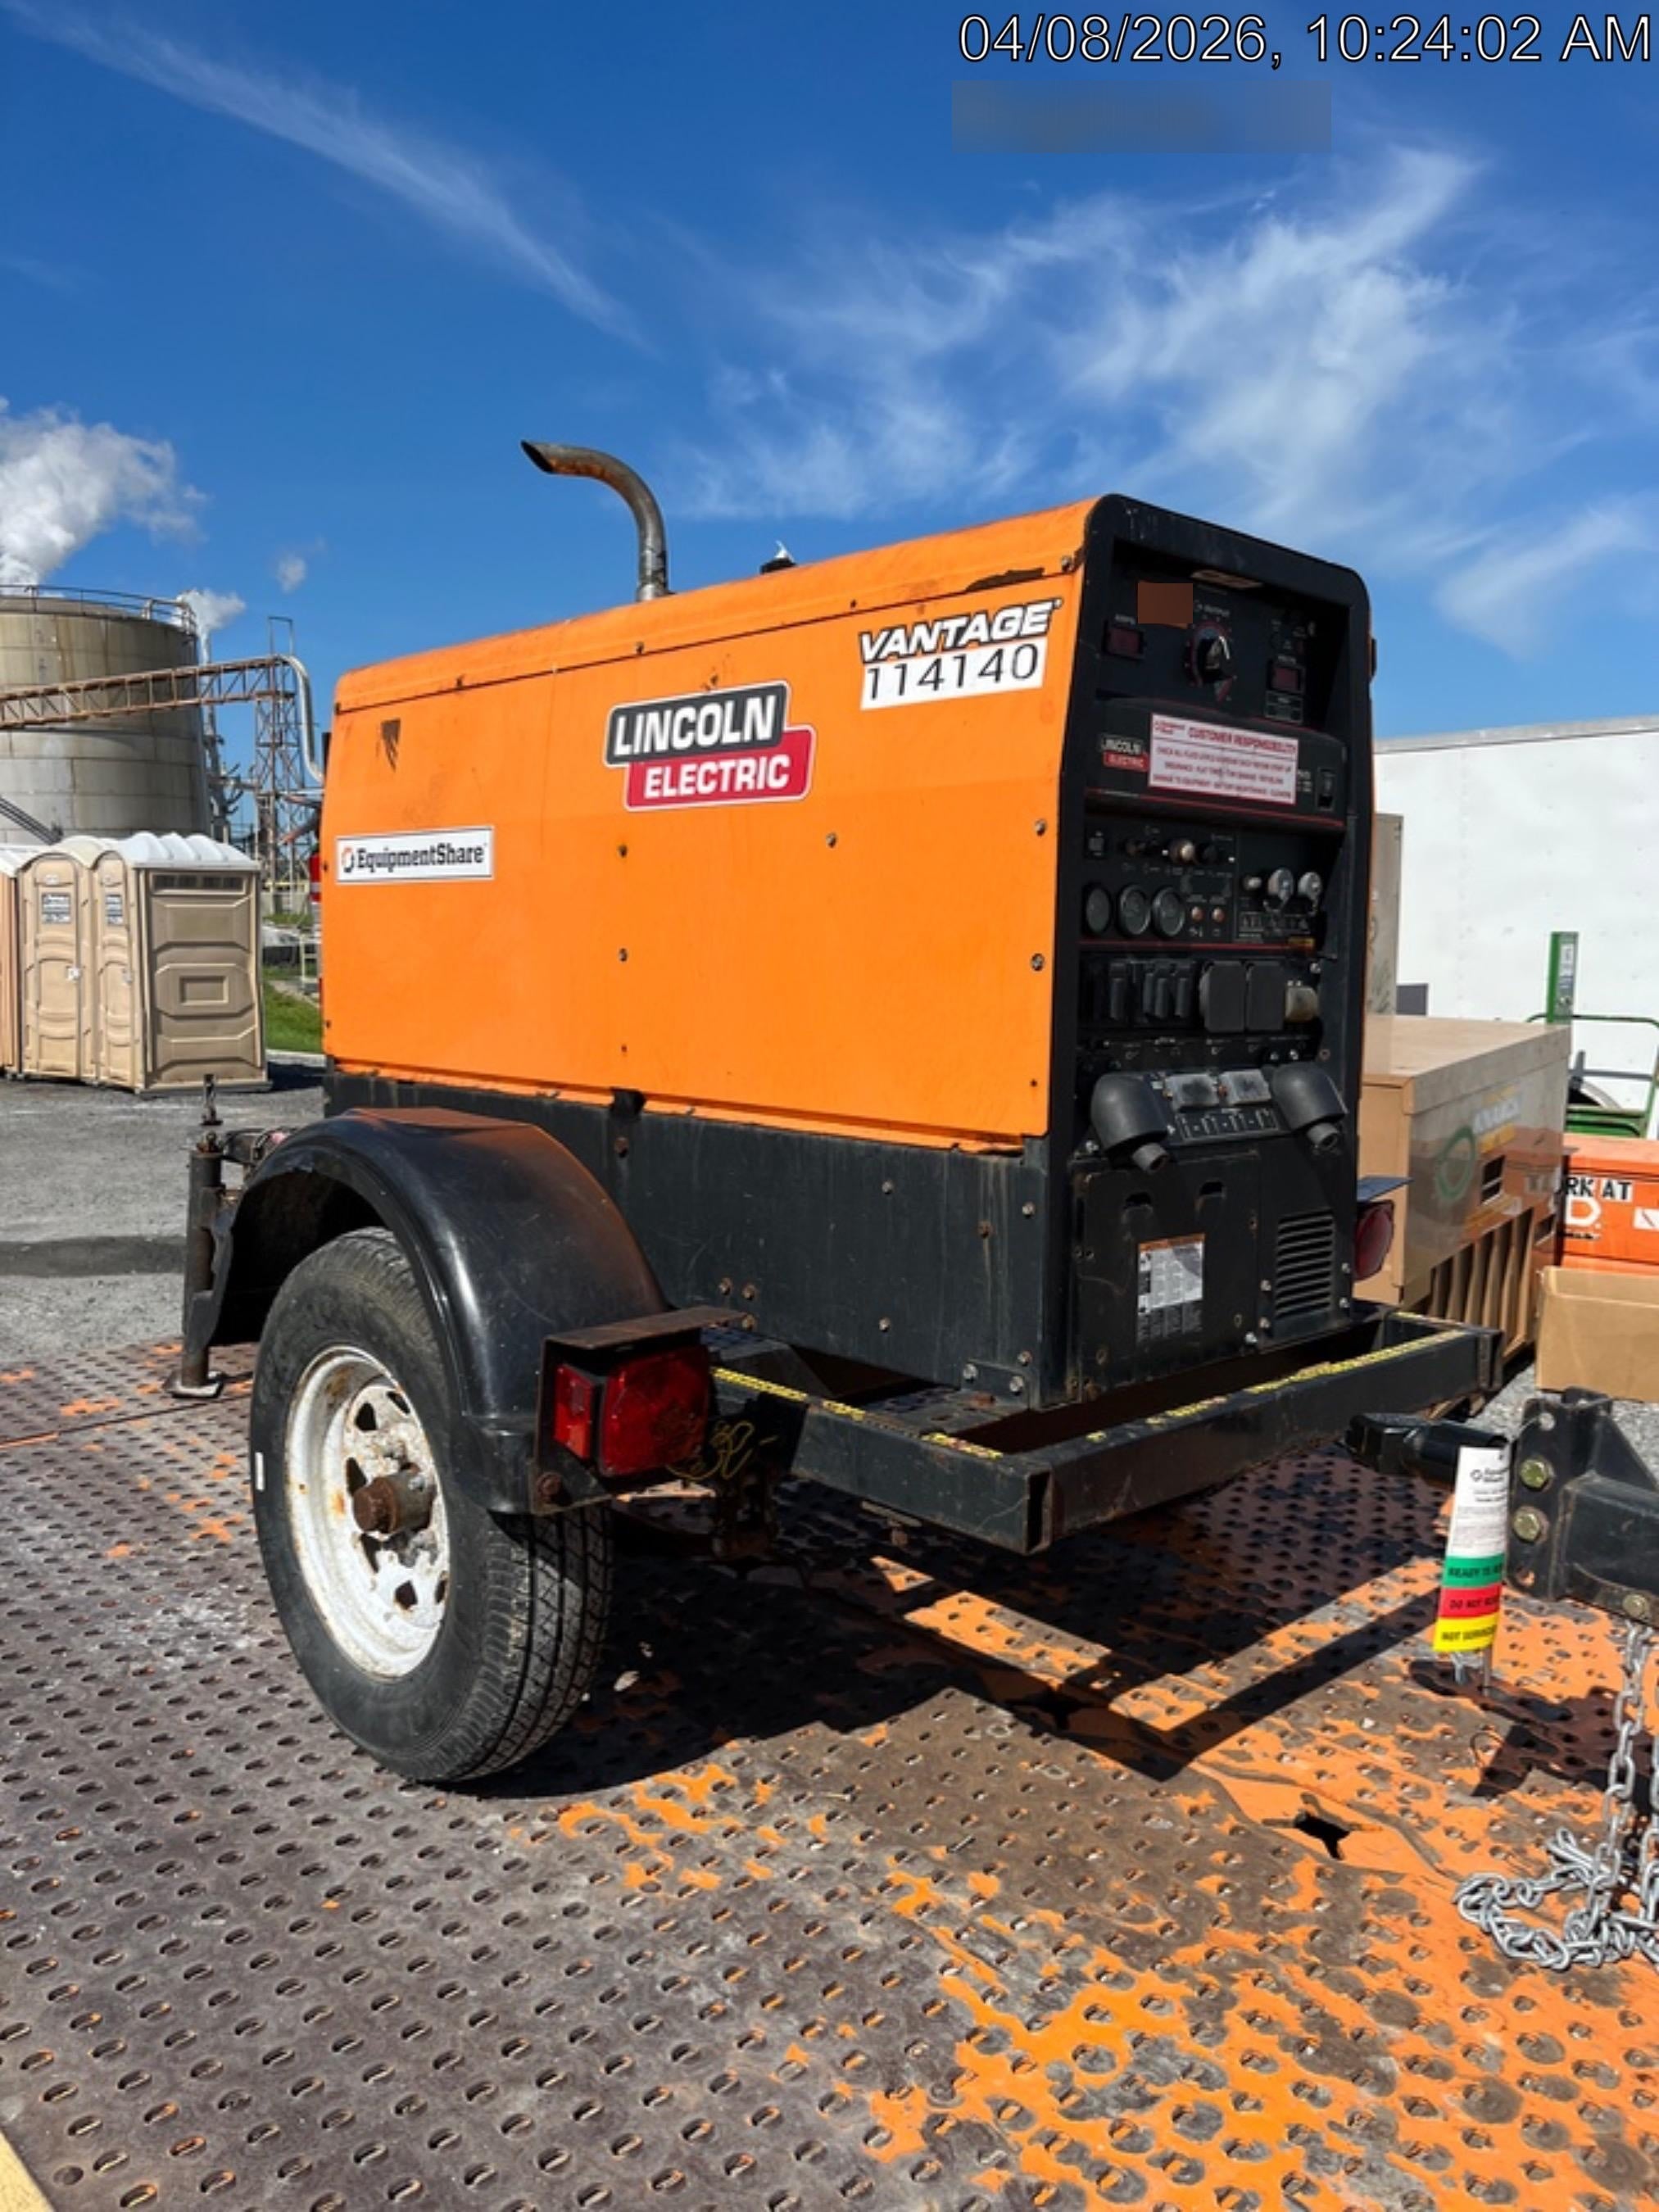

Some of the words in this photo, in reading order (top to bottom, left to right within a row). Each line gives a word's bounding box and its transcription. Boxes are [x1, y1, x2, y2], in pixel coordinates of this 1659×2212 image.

[859, 599, 1054, 664] VANTAGE
[868, 644, 1039, 700] 114140
[614, 695, 777, 756] LINCOLN
[644, 754, 791, 800] ELECTRIC
[357, 842, 484, 873] EquipmentShare
[1602, 1180, 1632, 1199] AT
